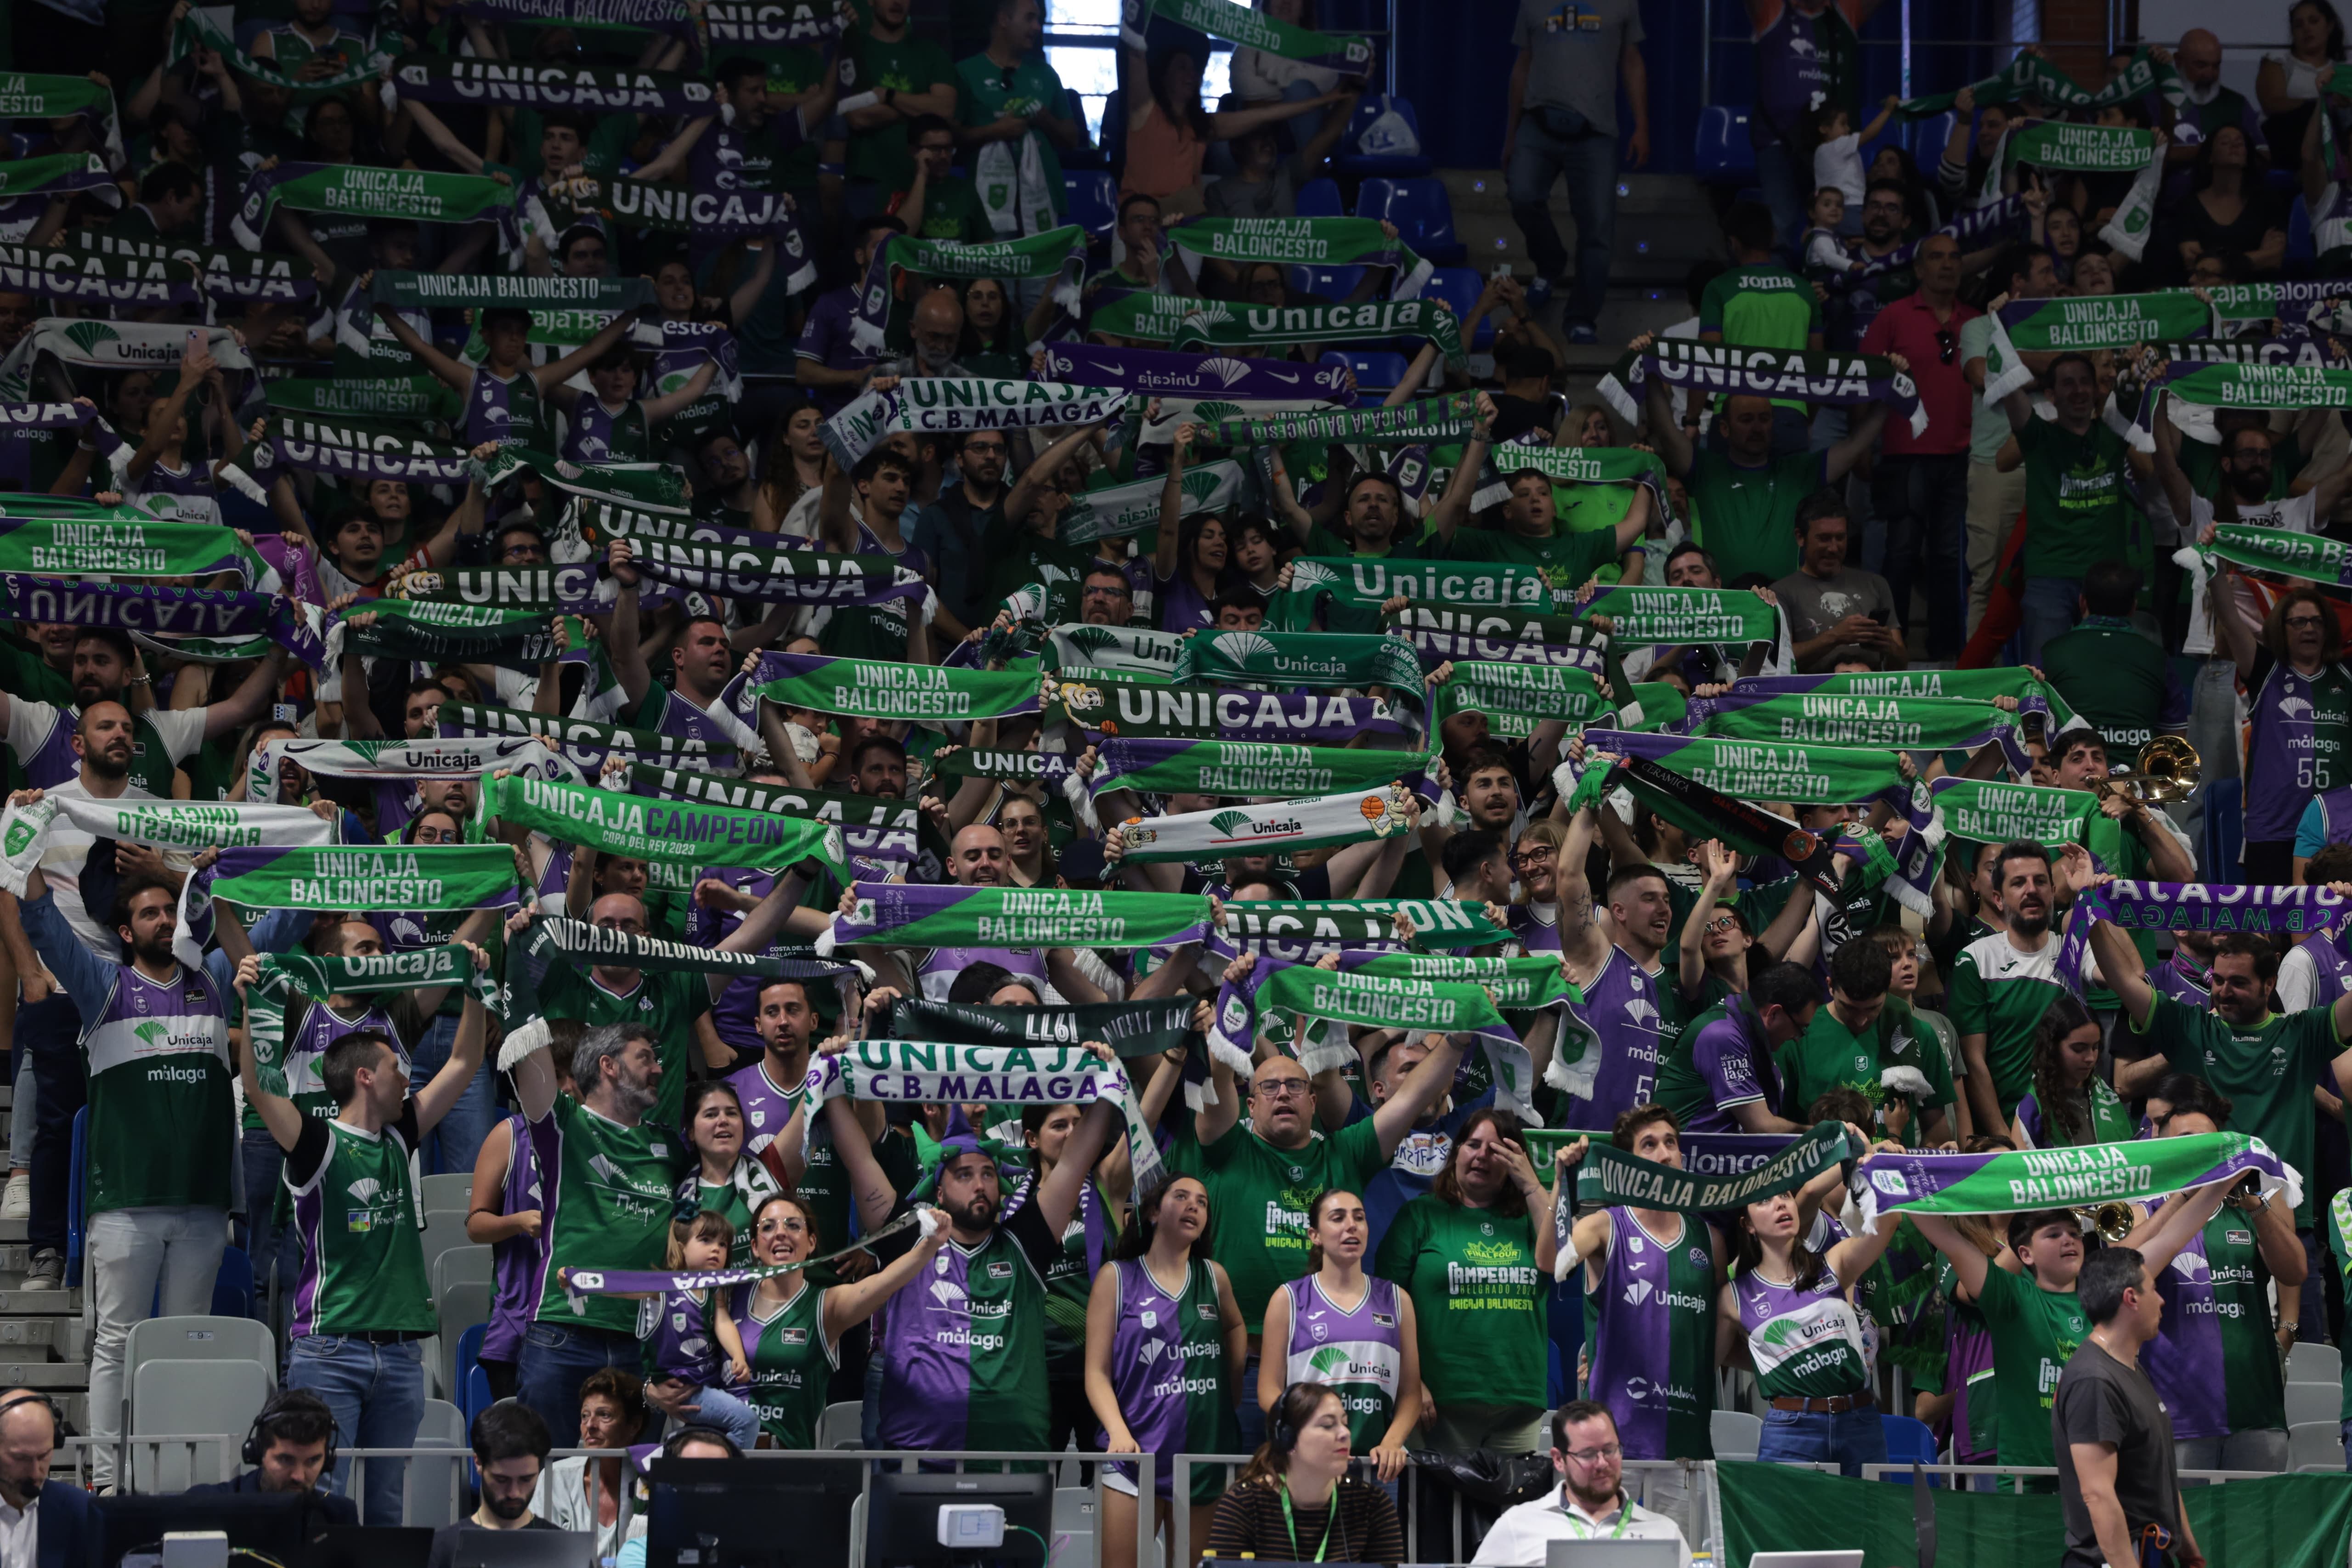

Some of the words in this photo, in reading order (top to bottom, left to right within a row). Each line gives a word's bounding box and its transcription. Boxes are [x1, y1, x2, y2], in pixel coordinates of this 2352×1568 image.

[573, 0, 688, 24] BALONCESTO
[1194, 0, 1266, 28] UNICAJA
[1181, 6, 1281, 51] BALONCESTO
[452, 62, 665, 108] UNICAJA
[2058, 127, 2135, 147] UNICAJA
[2041, 144, 2152, 164] BALONCESTO
[344, 169, 424, 194] UNICAJA
[325, 187, 442, 216] BALONCESTO
[612, 182, 790, 224] UNICAJA
[1233, 218, 1312, 237] UNICAJA
[1213, 233, 1328, 259] BALONCESTO
[0, 246, 170, 300] NICAJA
[919, 250, 1031, 275] BALONCESTO
[418, 275, 492, 299] UNICAJA
[498, 276, 599, 300] BALONCESTO
[1738, 275, 1796, 289] Joma
[2256, 280, 2352, 302] Balonces
[1248, 302, 1421, 331] Unicaja
[2064, 299, 2141, 322] UNICAJA
[2049, 320, 2159, 345] BALONCESTO
[118, 342, 180, 363] Unicaja
[1658, 341, 1870, 397] UNICAJA
[2240, 366, 2326, 384] UNICAJA
[315, 391, 429, 413] BALONCESTO
[913, 379, 1120, 408] UNICAJA
[2222, 382, 2346, 407] BALONCESTO
[897, 397, 912, 430] ACB
[1352, 408, 1418, 431] UNICAJA
[1253, 415, 1346, 439] BALONCESTO
[283, 418, 467, 477] UNICAJ
[1496, 457, 1601, 479] ALONCESTO
[176, 509, 210, 523] Unicaj
[53, 523, 145, 548] UNICAJA
[32, 546, 166, 571] BALONCESTO
[1353, 563, 1542, 608] Unicaja
[408, 601, 504, 627] UNICAJA
[1631, 593, 1723, 614] UNICAJA
[358, 632, 382, 644] Unicaja
[1613, 615, 1742, 639] BALONCESTO
[855, 664, 949, 690] UNICAJA
[1273, 655, 1347, 674] Unicaja
[1471, 664, 1566, 691] UNICAJA
[1849, 674, 1942, 697] UNICAJA
[835, 685, 970, 713] BALONCESTO
[1118, 688, 1356, 729] UNICAJA
[1456, 685, 1587, 716] BALONCESTO
[1803, 696, 1900, 721] UNICAJA
[2311, 709, 2349, 724] Unicaja
[462, 706, 711, 775] UNICAJA
[1166, 730, 1308, 739] BALONCESTO
[1781, 717, 1921, 745] BALONCESTO
[1220, 744, 1313, 767] UNICAJA
[2288, 736, 2341, 753] málaga
[405, 748, 483, 770] Unicaja
[1714, 744, 1809, 772] UNICAJA
[1199, 765, 1333, 791] BALONCESTO
[1641, 762, 1689, 792] CERAMICA
[1693, 767, 1829, 797] BALONCESTO
[2297, 757, 2330, 789] 55
[524, 779, 643, 834] UNICAJA
[645, 807, 785, 845] CAMPEÓN
[1287, 797, 1322, 807] CHICUI
[1978, 787, 2066, 818] UNICAJA
[1253, 818, 1302, 834] Unicaja
[1958, 808, 2084, 840] BALONCESTO
[602, 830, 627, 846] COPA
[628, 834, 645, 850] DEL
[647, 837, 666, 853] REY
[668, 840, 695, 855] 2023
[314, 853, 419, 878] UNICAJA
[291, 878, 442, 905] BALONCESTO
[1817, 870, 1839, 893] Unicaja
[1003, 892, 1103, 916] UNICAJA
[548, 917, 628, 953] UNICAJA
[637, 934, 756, 965] BALONCESTO
[978, 916, 1125, 942] BALONCESTO
[344, 947, 454, 980] Unicaja
[1411, 957, 1509, 977] UNICAJA
[1337, 971, 1434, 996] UNICAJA
[1314, 985, 1456, 1024] BALONCESTO
[167, 1033, 213, 1047] Unicaja
[1025, 1012, 1079, 1043] 1977
[2231, 1034, 2262, 1043] hummel
[858, 1041, 1108, 1072] UNICAJA
[147, 1064, 206, 1084] málaga
[840, 1055, 856, 1095] ACB
[1863, 1090, 1885, 1099] FOUR
[1600, 1156, 1692, 1207] UNICAJA
[1700, 1137, 1822, 1208] BALONCESTO
[2022, 1147, 2128, 1177] UNICAJA
[2009, 1164, 2152, 1205] BALONCESTO
[1266, 1200, 1311, 1234] CAMPE
[1266, 1236, 1303, 1248] UNICAJA
[1467, 1249, 1493, 1259] FINAL
[1493, 1249, 1518, 1260] FOUR
[1447, 1261, 1538, 1296] CAMPEONES
[2209, 1265, 2254, 1282] Unicaja
[1460, 1284, 1511, 1295] BELGRADO
[1516, 1285, 1536, 1295] 2024
[1655, 1290, 1707, 1314] Unicaja
[964, 1299, 1012, 1315] Unicaja
[1448, 1298, 1487, 1310] UNICAJA
[2186, 1297, 2245, 1319] málaga
[937, 1326, 1004, 1351] málaga
[1801, 1315, 1846, 1340] Unicaja
[1166, 1338, 1221, 1362] Unicaja
[1792, 1346, 1849, 1378] málaga
[748, 1368, 802, 1386] Unicaja
[1350, 1360, 1391, 1379] Unicaja
[1153, 1375, 1217, 1398] málaga
[1651, 1379, 1697, 1403] Andalucía
[1341, 1393, 1382, 1414] álaga
